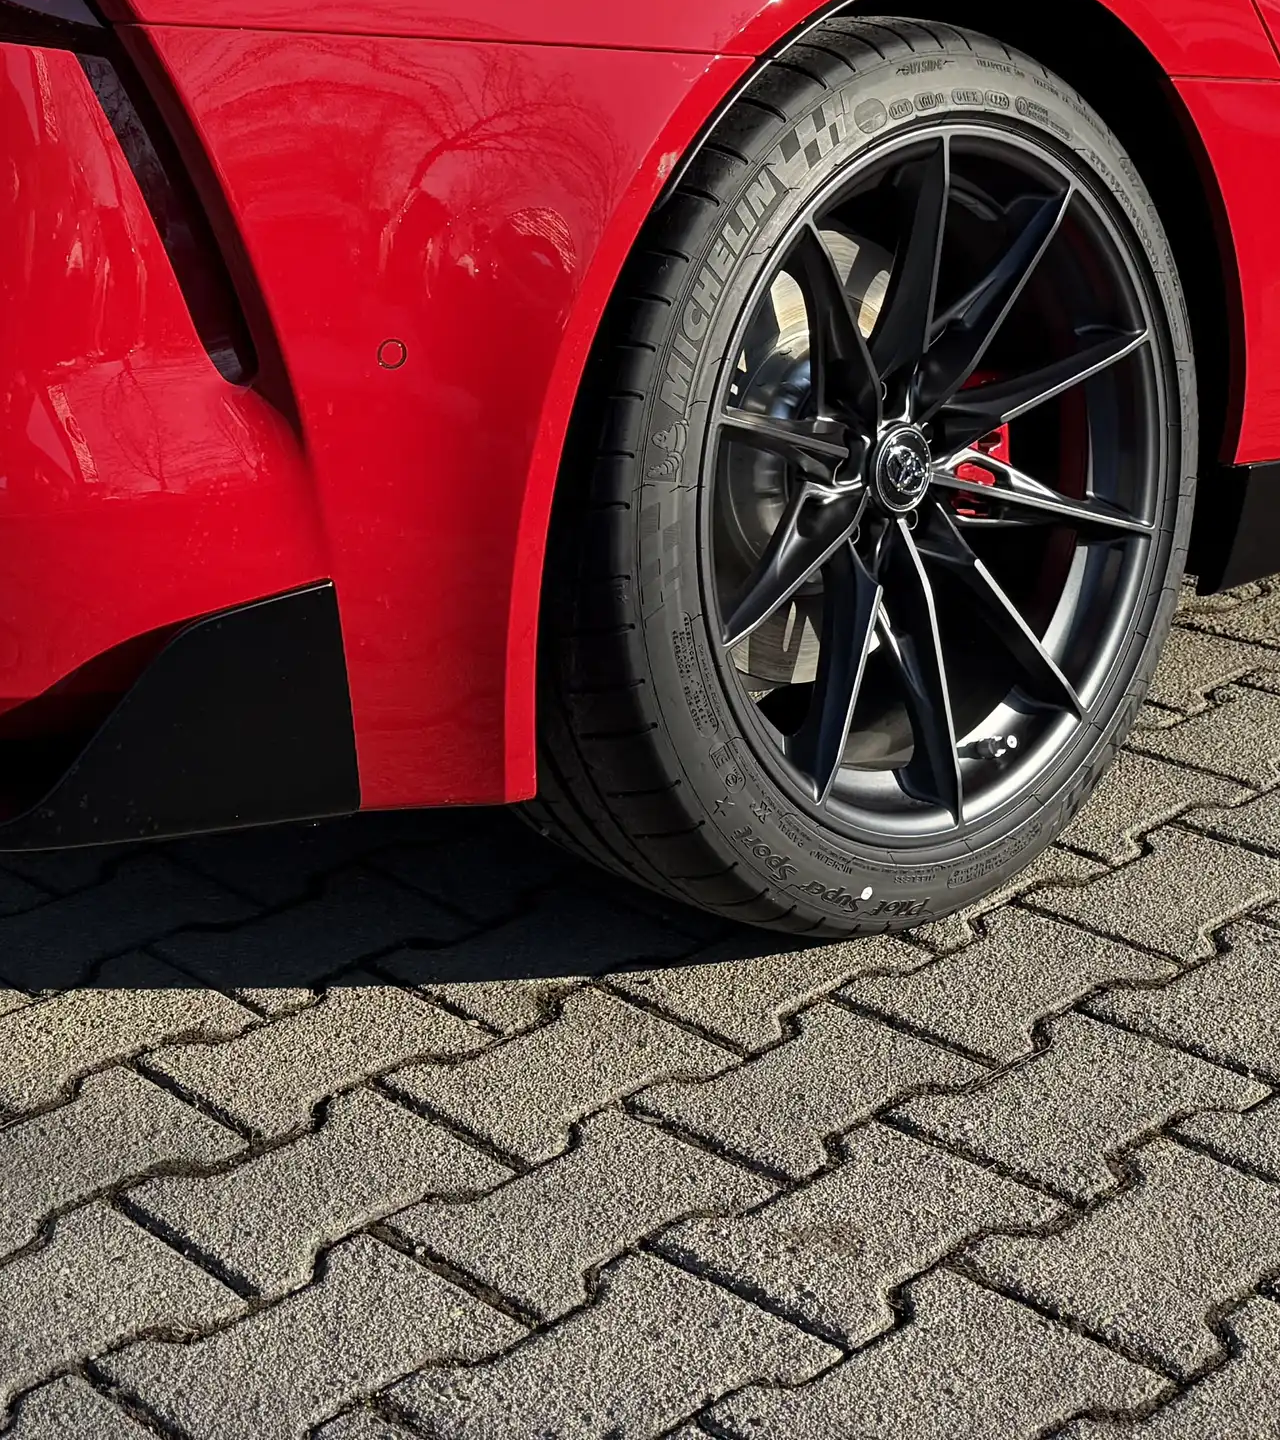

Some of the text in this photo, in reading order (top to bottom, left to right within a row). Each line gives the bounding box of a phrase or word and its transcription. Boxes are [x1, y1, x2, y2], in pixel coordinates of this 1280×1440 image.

[659, 167, 778, 413] MICHELIN
[731, 824, 930, 917] Pilot Super Sport
